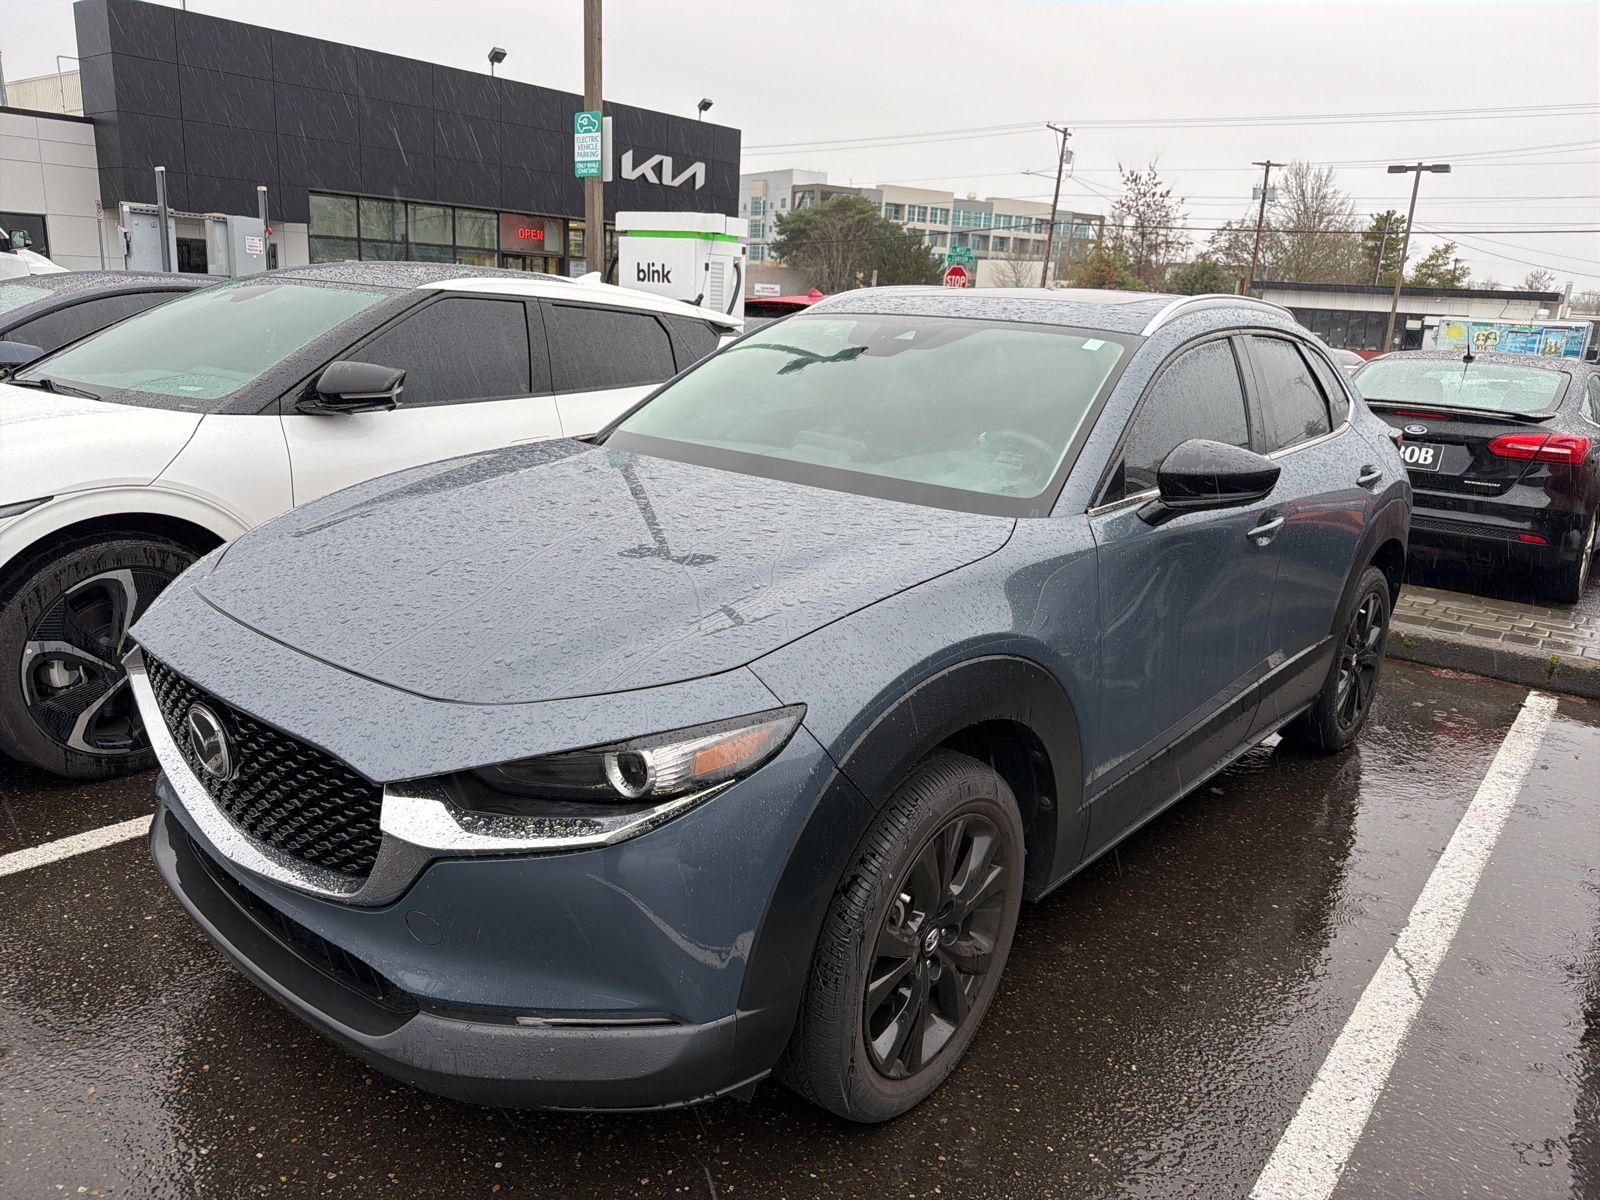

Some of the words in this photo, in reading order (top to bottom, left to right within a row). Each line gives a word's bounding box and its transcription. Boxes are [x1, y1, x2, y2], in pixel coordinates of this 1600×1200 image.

[576, 135, 599, 143] ELECTRIC
[577, 143, 599, 151] VEHICLE
[576, 151, 599, 159] PARKING
[621, 149, 705, 190] KIA
[518, 228, 544, 240] OPEN
[637, 262, 672, 284] blink
[946, 275, 966, 287] STOP
